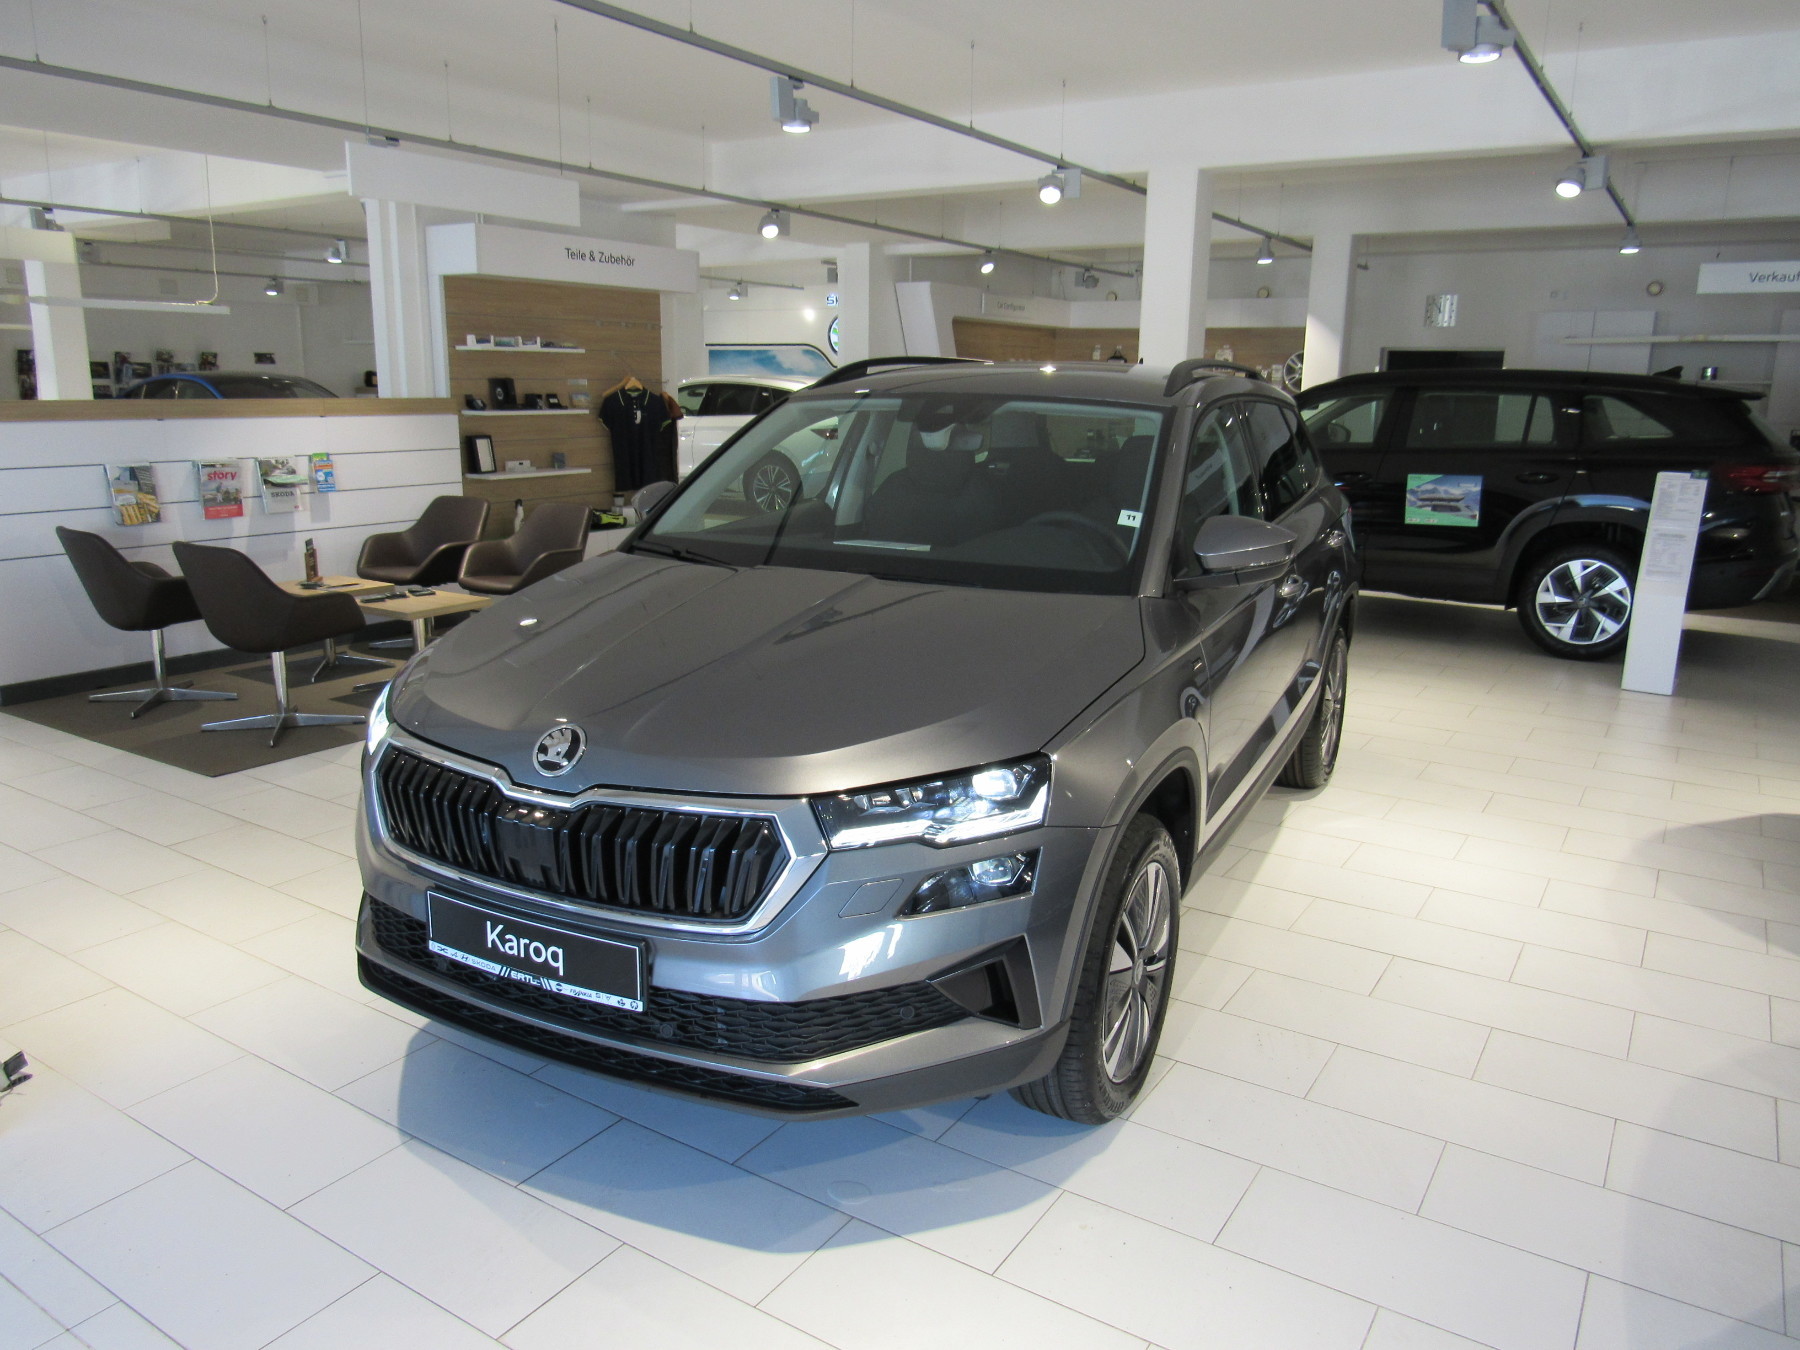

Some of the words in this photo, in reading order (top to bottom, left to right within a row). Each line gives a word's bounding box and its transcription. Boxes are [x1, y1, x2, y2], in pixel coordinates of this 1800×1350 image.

[565, 247, 587, 261] Teile
[589, 249, 596, 262] &
[598, 251, 635, 267] Zubehör
[207, 470, 237, 481] story
[486, 920, 564, 976] Karoq
